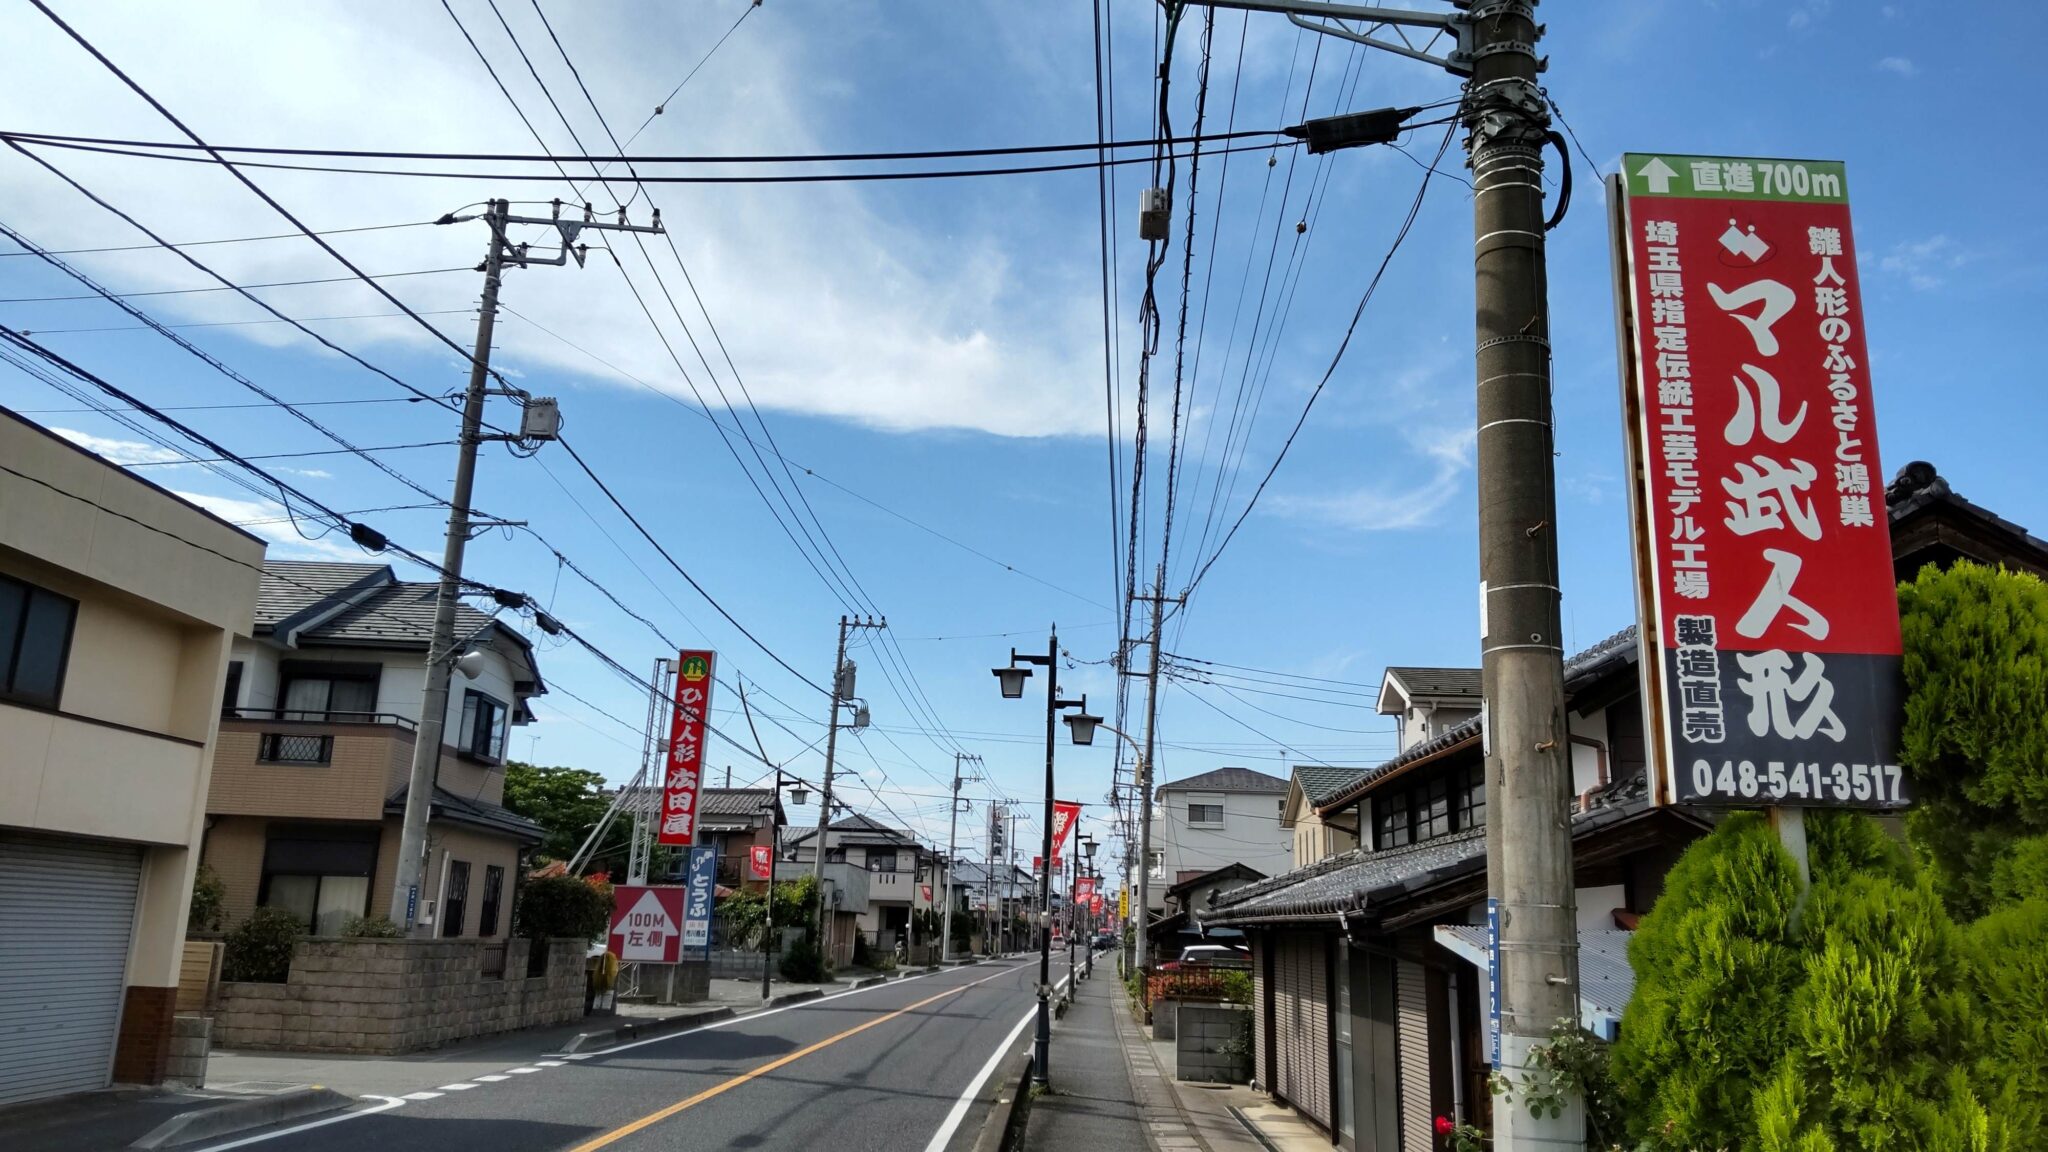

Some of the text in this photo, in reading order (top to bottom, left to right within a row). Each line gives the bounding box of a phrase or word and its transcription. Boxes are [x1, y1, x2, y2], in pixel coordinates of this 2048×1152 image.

[1645, 220, 1710, 599] 埼玉県指定伝統工芸モデル工場
[1807, 226, 1875, 528] 雛人形のふるさと鴻巣
[1707, 278, 1847, 743] マル武人形
[1674, 614, 1726, 744] 製造直売
[1692, 760, 1902, 801] 048-541-3517
[627, 930, 664, 948] 左側
[628, 912, 666, 928] 100M
[689, 873, 710, 918] とうふ
